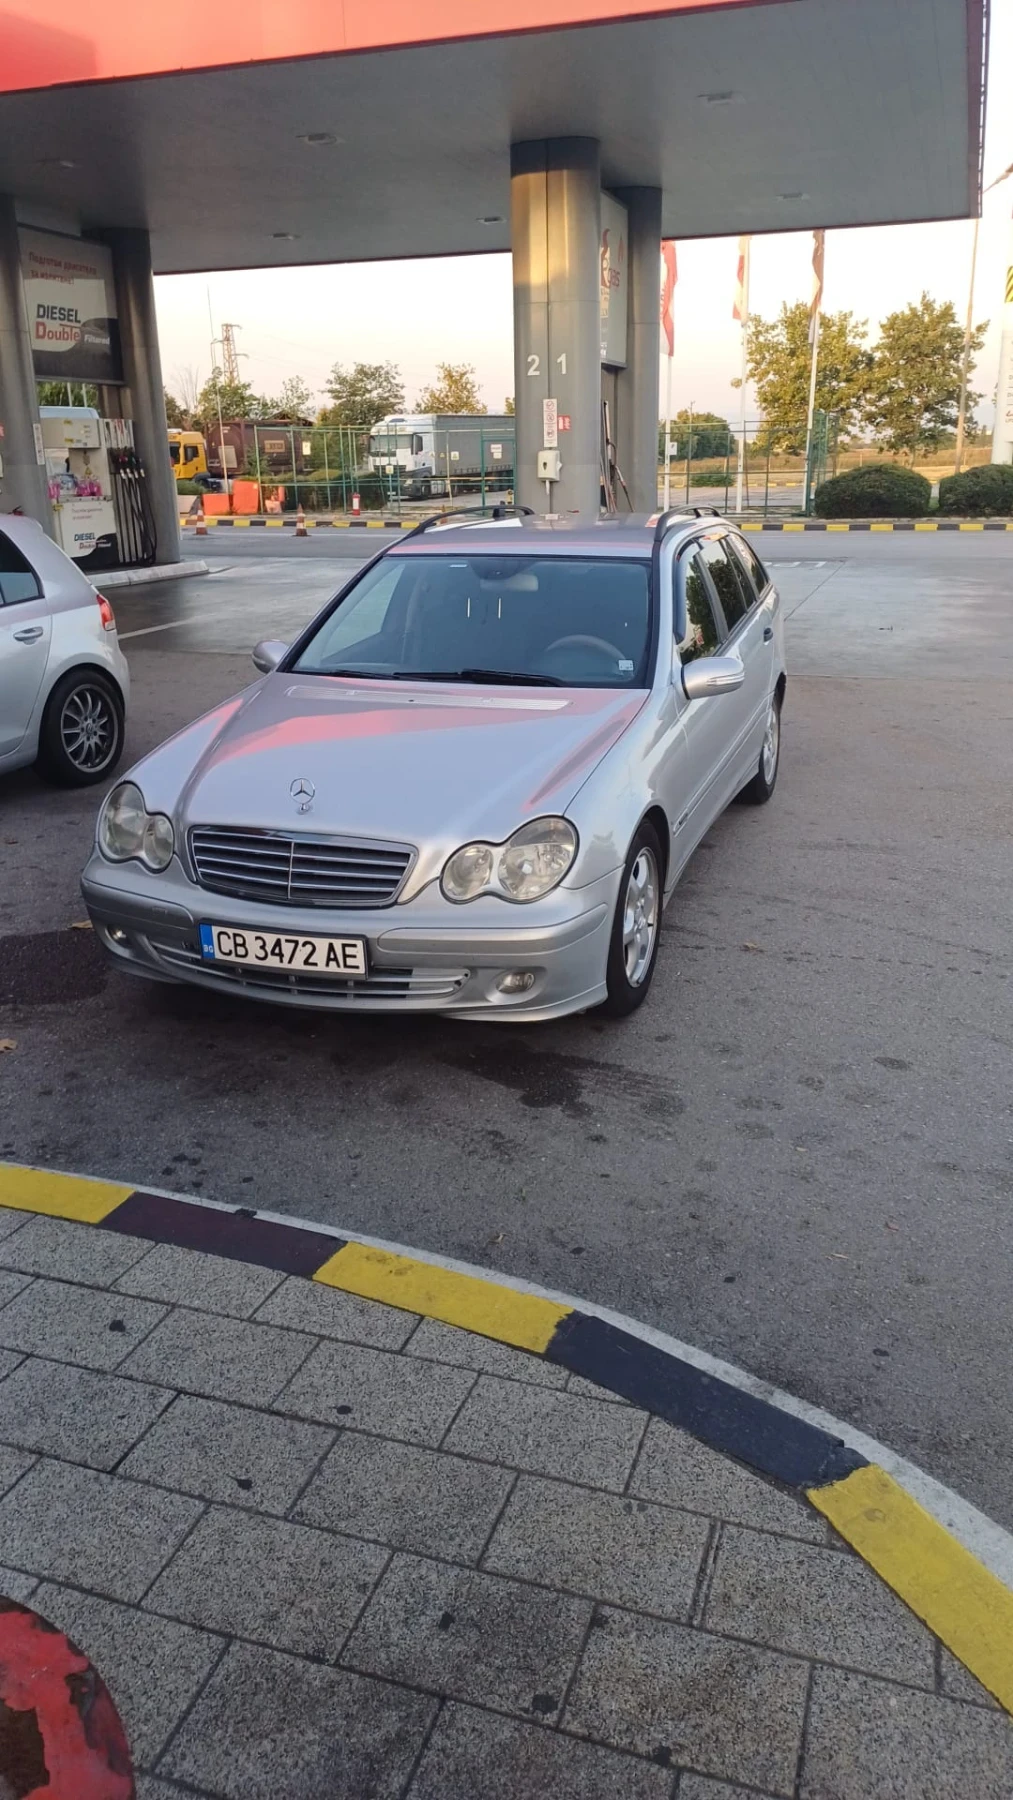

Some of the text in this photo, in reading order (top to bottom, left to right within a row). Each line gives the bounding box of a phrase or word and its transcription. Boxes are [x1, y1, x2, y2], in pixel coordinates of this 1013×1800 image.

[37, 303, 81, 323] DIESEL
[35, 321, 110, 345] Double Filtered
[527, 354, 540, 376] 2
[556, 353, 567, 375] 1
[74, 532, 96, 542] DIESEL
[217, 931, 360, 970] CB 3472 AE
